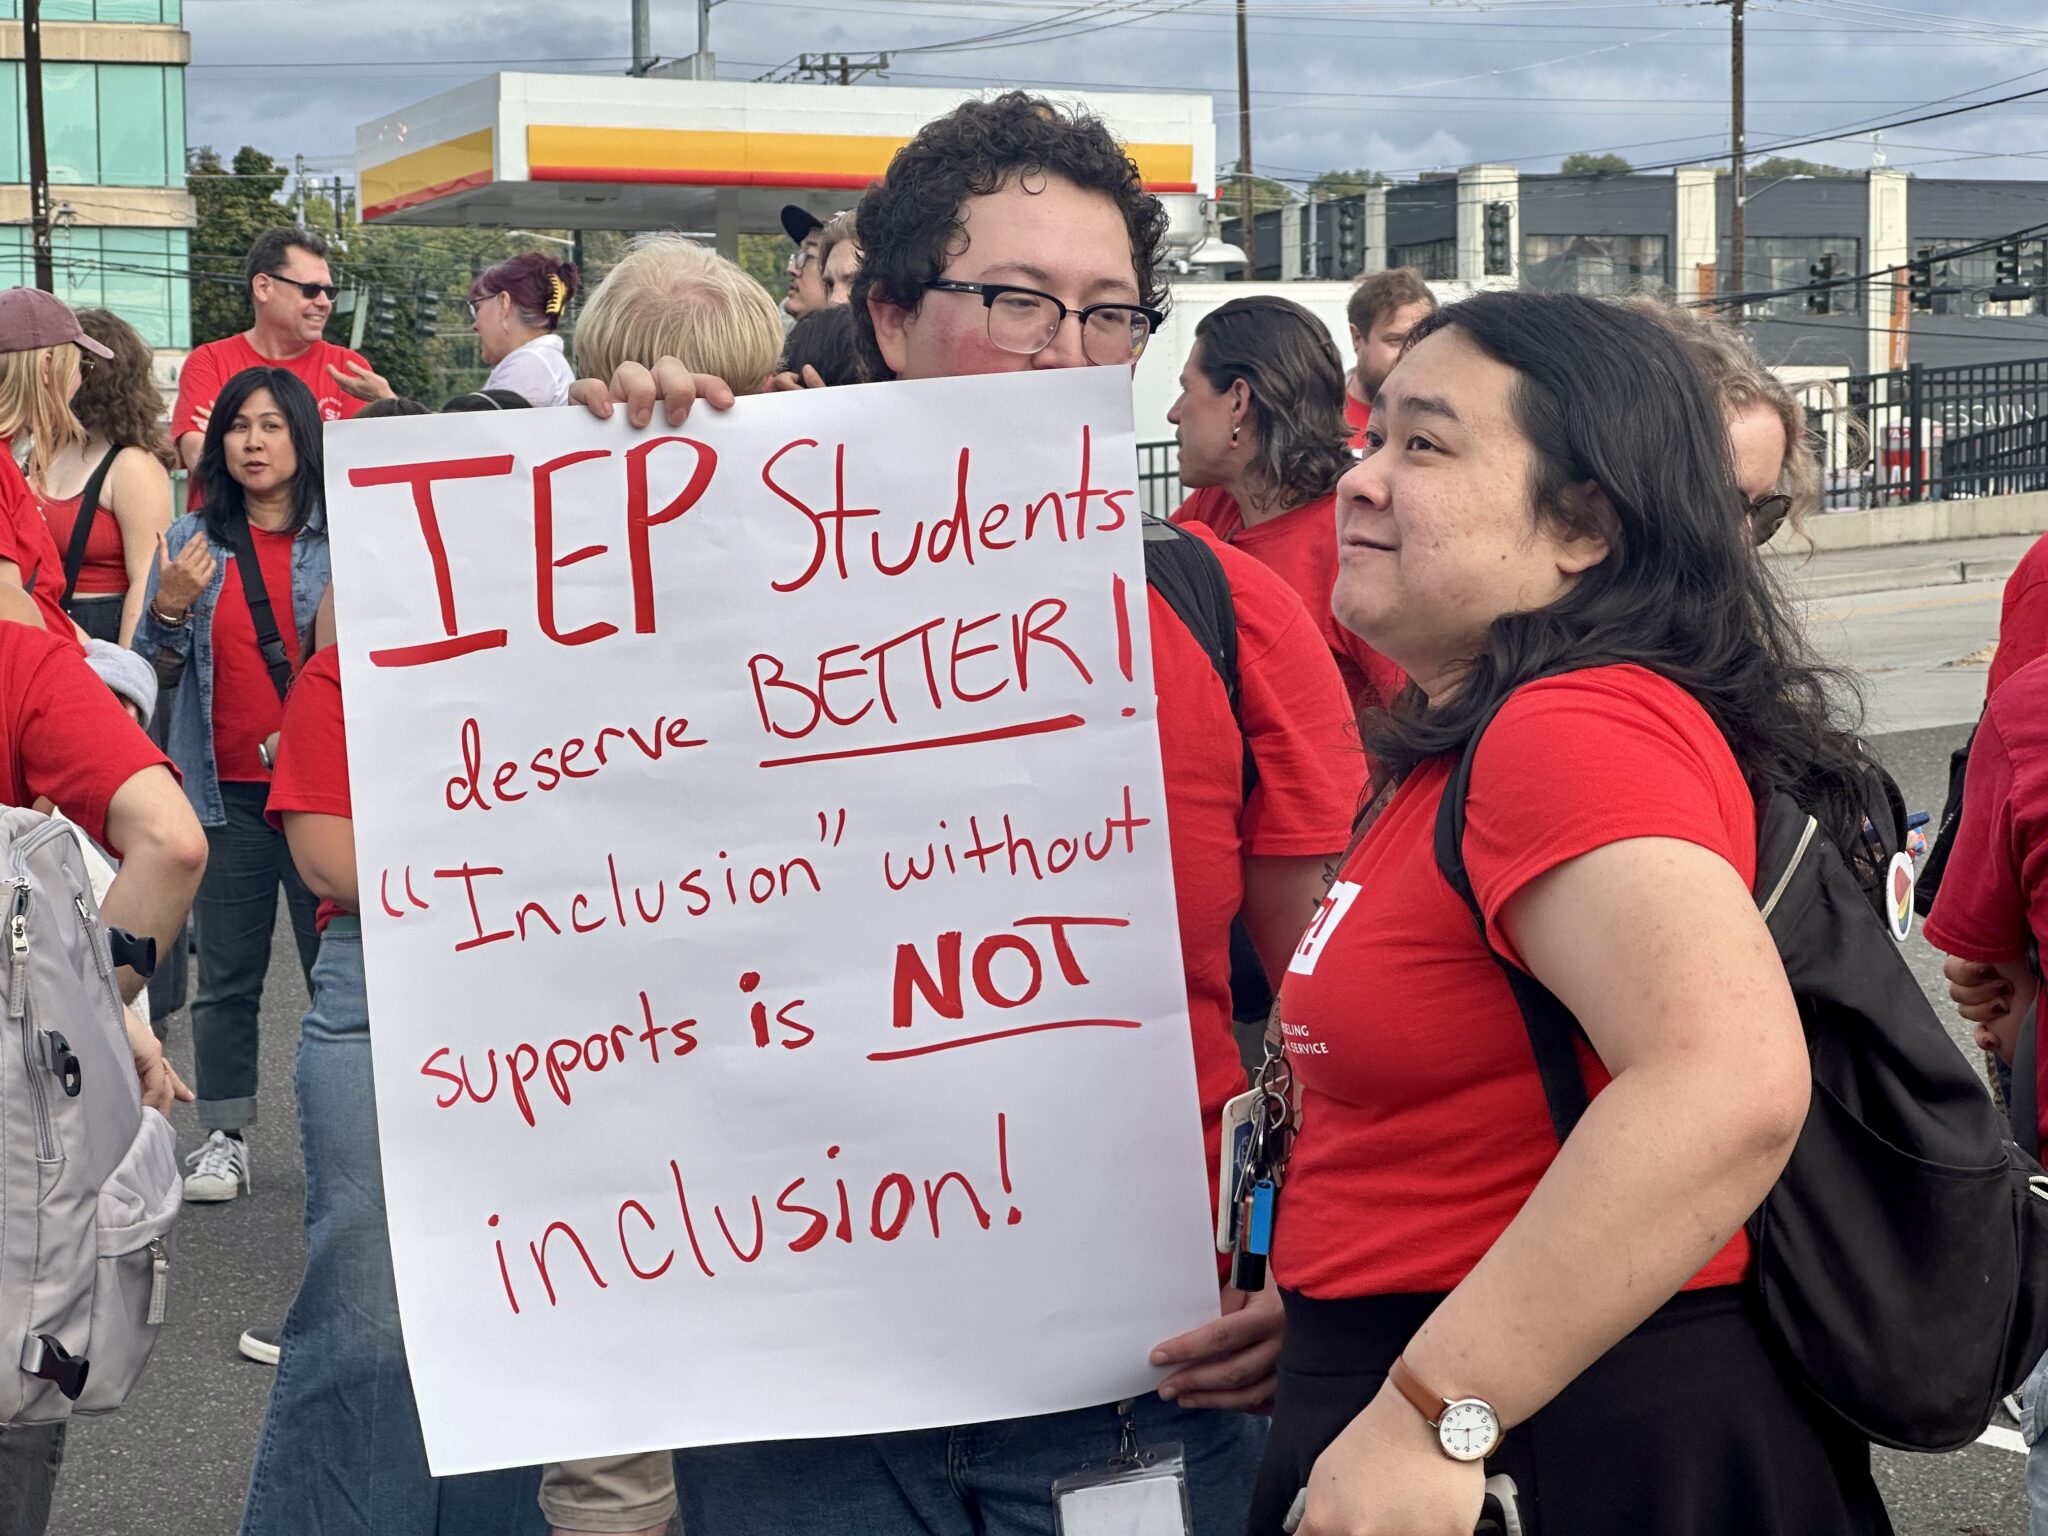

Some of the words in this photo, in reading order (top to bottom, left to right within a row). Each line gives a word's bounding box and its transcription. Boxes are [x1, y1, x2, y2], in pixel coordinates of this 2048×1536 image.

[348, 437, 718, 667] IEP
[761, 425, 1134, 592] Students
[446, 716, 708, 810] deserve
[748, 573, 1136, 739] BETTER!
[884, 785, 1151, 891] without
[420, 991, 698, 1127] supports
[739, 971, 815, 1050] is
[892, 916, 1130, 1028] NOT
[1290, 1041, 1329, 1055] SERVICE
[487, 1112, 1022, 1314] inclusion!
